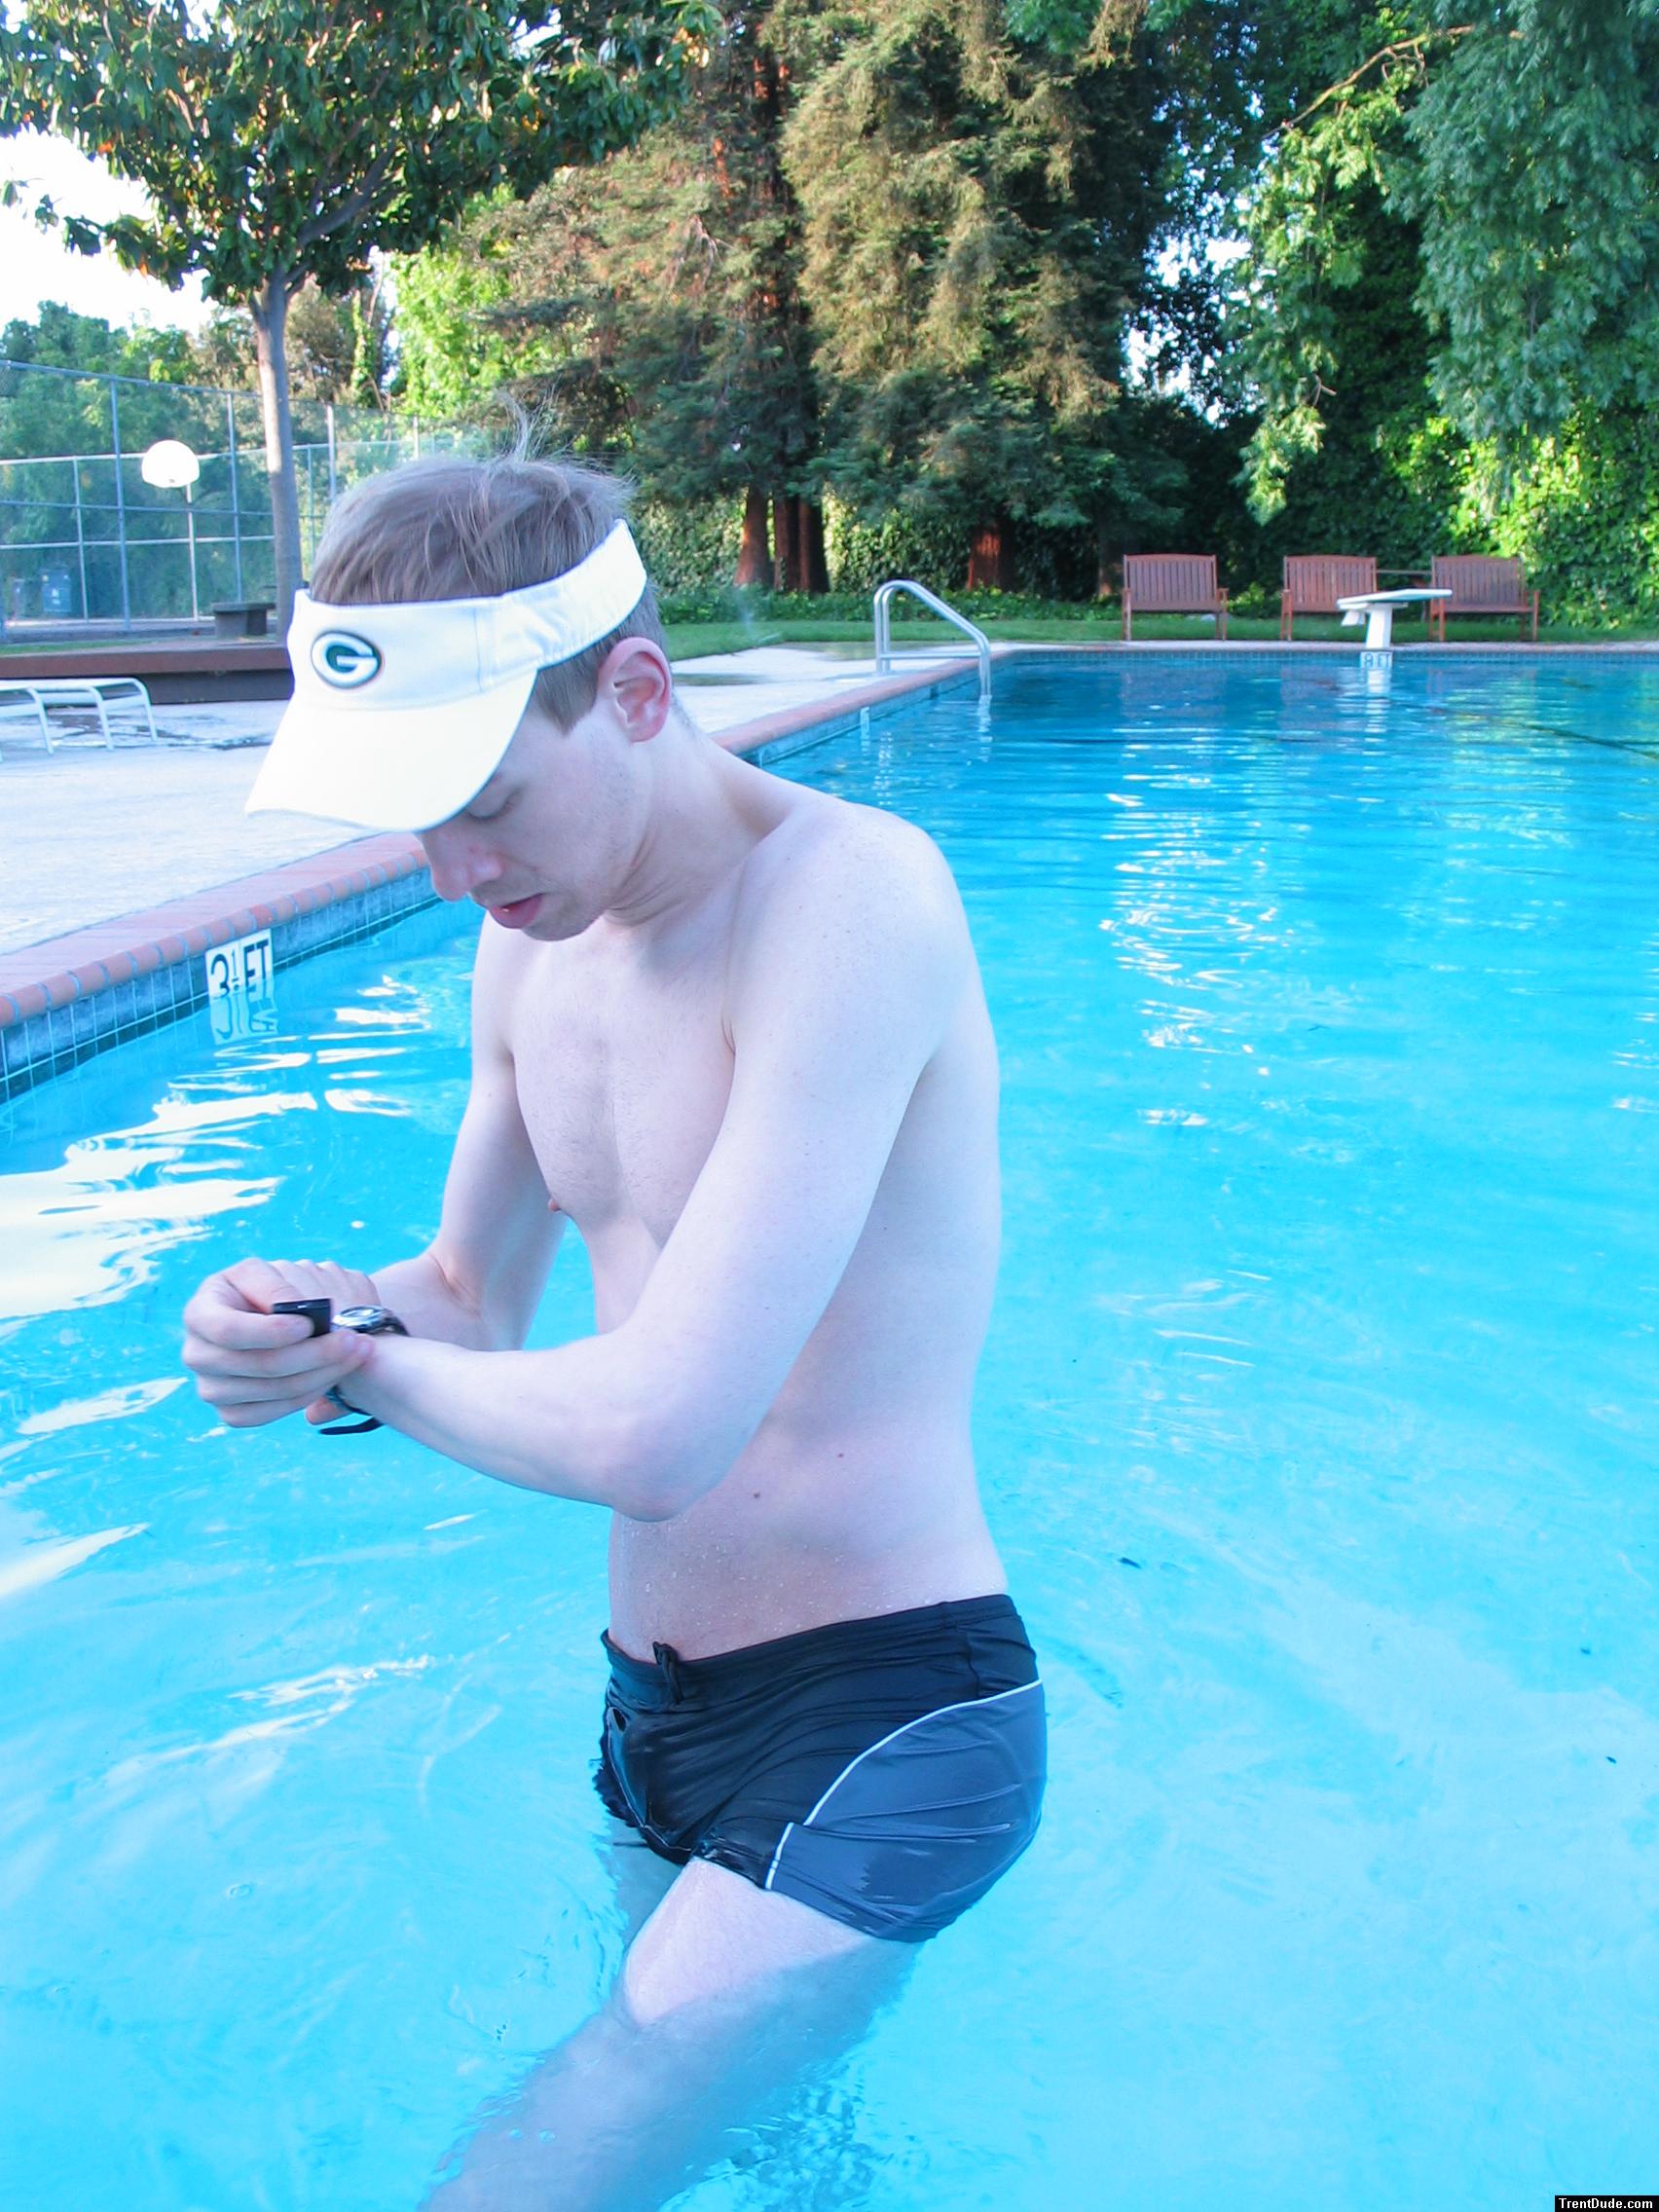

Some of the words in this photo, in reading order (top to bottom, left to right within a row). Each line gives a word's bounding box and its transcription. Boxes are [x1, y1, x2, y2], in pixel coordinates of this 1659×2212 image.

[311, 630, 383, 689] G
[1378, 652, 1390, 668] FT
[243, 939, 269, 987] FT
